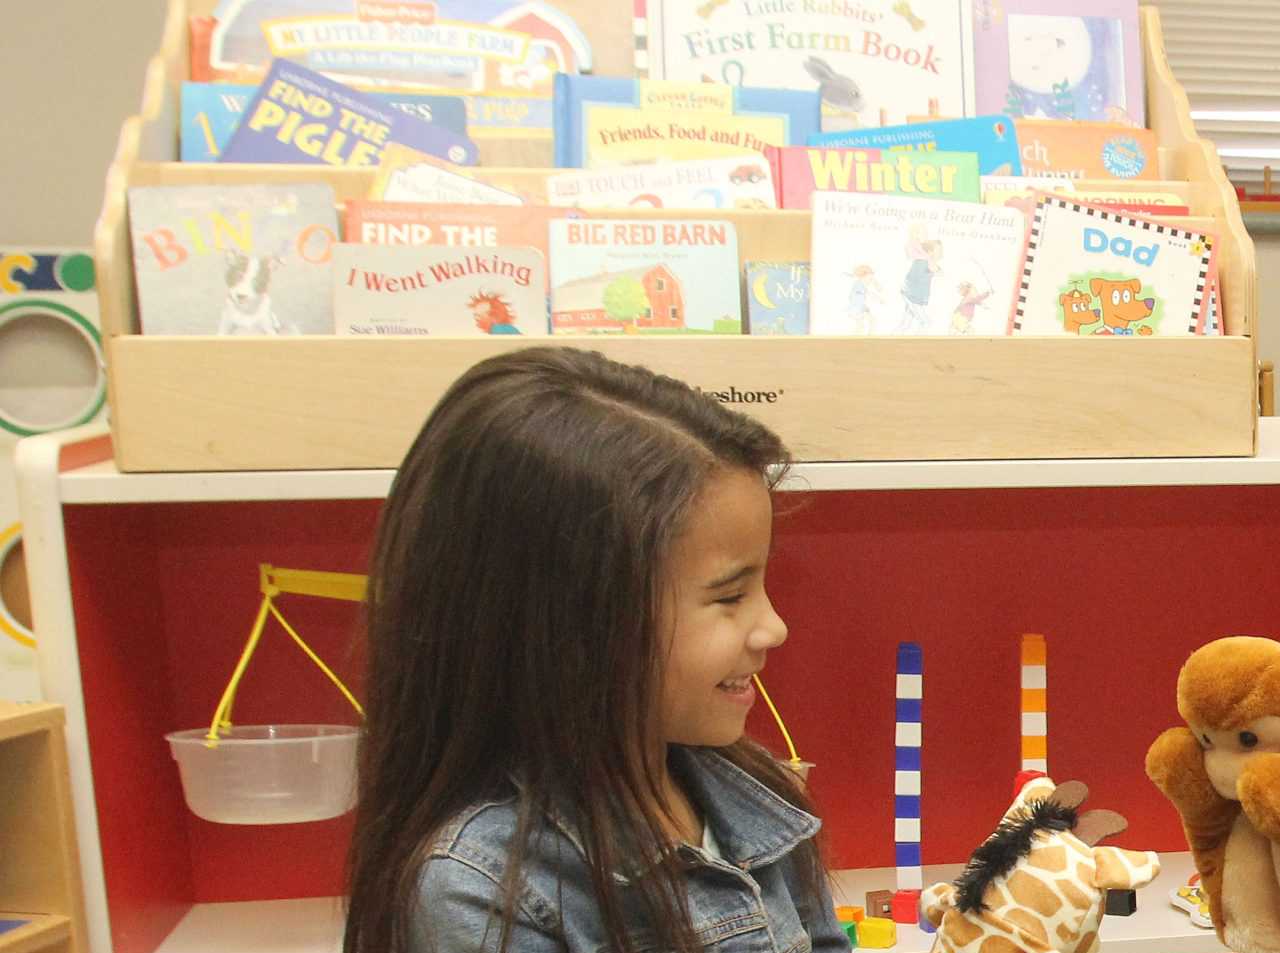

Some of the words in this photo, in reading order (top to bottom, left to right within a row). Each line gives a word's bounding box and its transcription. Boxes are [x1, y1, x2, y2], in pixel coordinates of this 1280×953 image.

[744, 0, 796, 16] Little
[683, 26, 757, 60] First
[766, 22, 853, 52] Farm
[861, 29, 943, 75] Book
[248, 98, 386, 166] PIGLE
[268, 79, 334, 118] FIND
[339, 108, 390, 146] THE
[599, 124, 664, 146] Friends,
[668, 123, 706, 142] Food
[710, 127, 740, 146] and
[807, 149, 958, 194] Winter
[361, 222, 433, 246] FIND
[440, 224, 498, 247] THE
[567, 222, 609, 246] BIG
[613, 222, 657, 246] RED
[662, 222, 728, 246] BARN
[910, 207, 928, 219] on
[980, 210, 1016, 228] Hunt
[143, 210, 338, 272] BINO
[1082, 226, 1161, 268] Dad
[346, 267, 359, 288] I
[362, 269, 428, 294] Went
[428, 254, 533, 288] Walking
